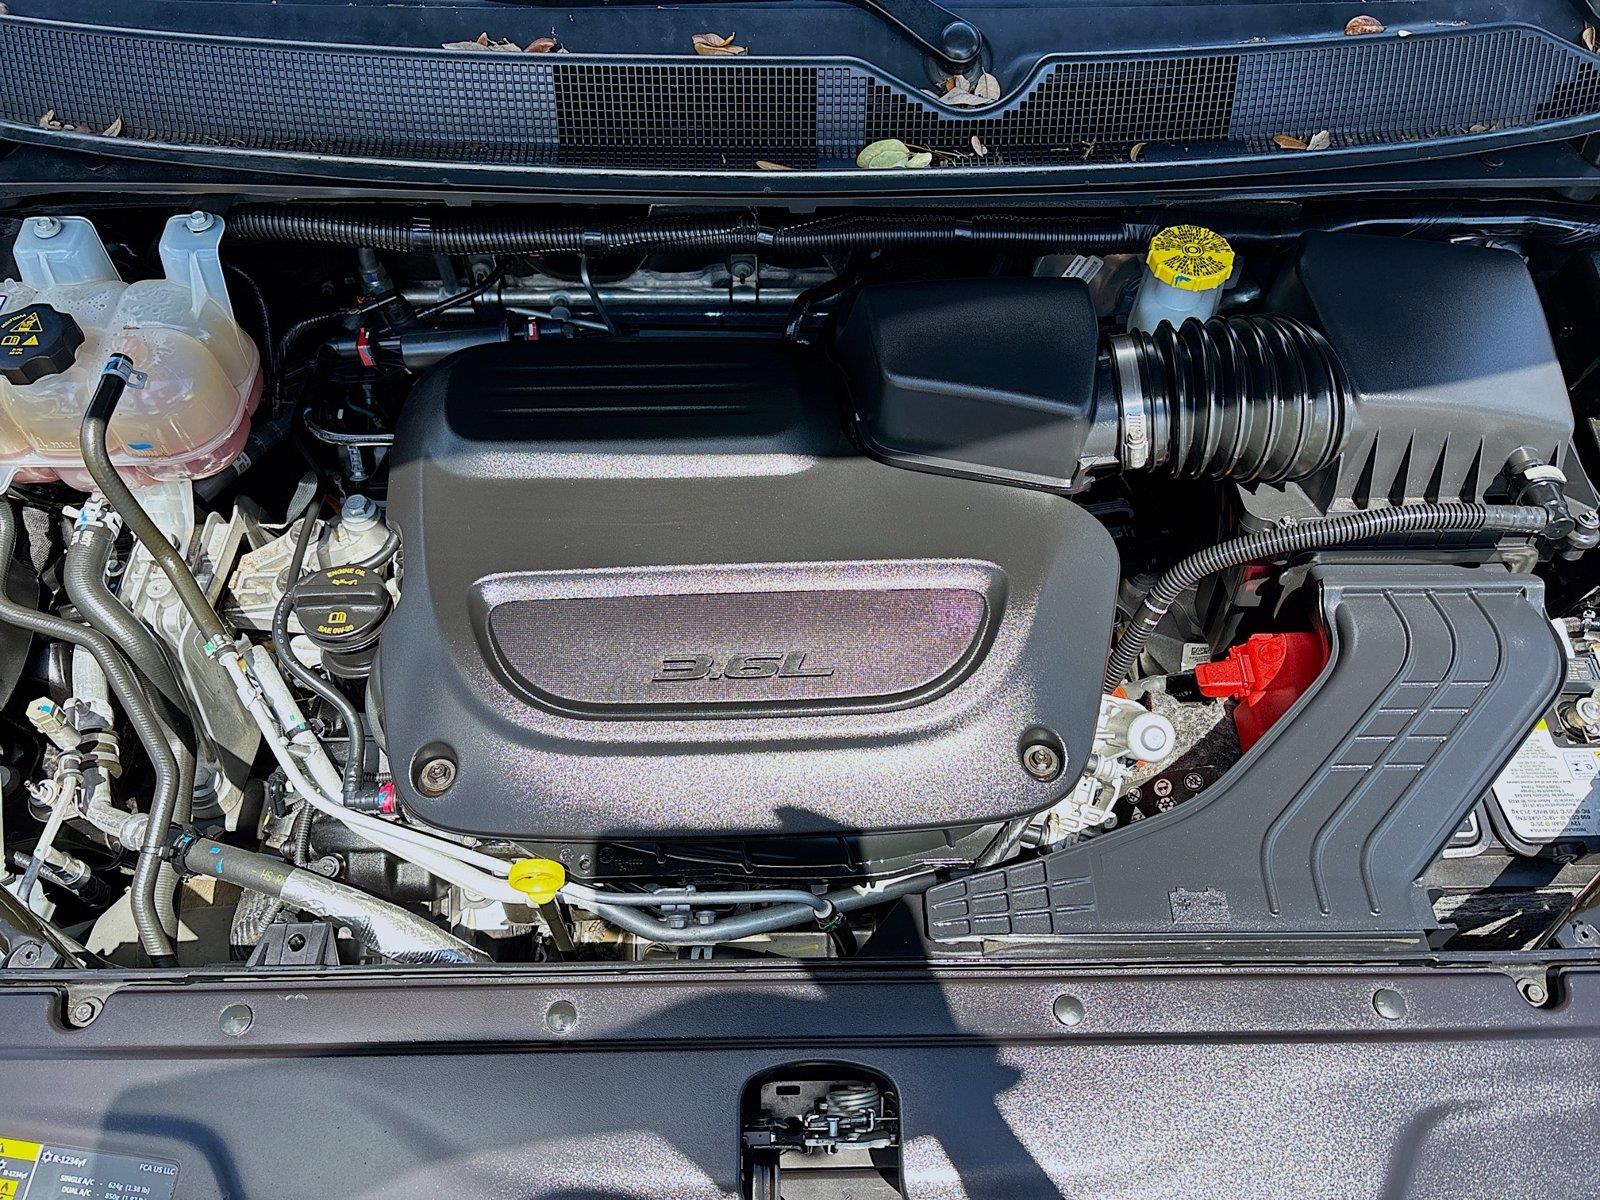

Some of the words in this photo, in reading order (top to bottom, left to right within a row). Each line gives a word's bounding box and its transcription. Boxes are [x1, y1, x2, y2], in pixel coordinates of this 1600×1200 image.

[326, 568, 354, 577] ENGINE
[318, 624, 332, 634] SAE
[332, 624, 354, 634] 0W-20
[651, 651, 835, 682] 3.6L
[53, 1154, 87, 1168] R-1234yf
[140, 1163, 152, 1173] FCA
[153, 1166, 164, 1174] US
[164, 1168, 176, 1176] LLC
[60, 1174, 82, 1184] SINGLE
[82, 1177, 96, 1186] A/C
[108, 1182, 123, 1192] 624g
[125, 1184, 141, 1193] (1.38
[141, 1186, 151, 1196] lb)
[61, 1186, 78, 1195] DUAL
[78, 1188, 92, 1197] A/C
